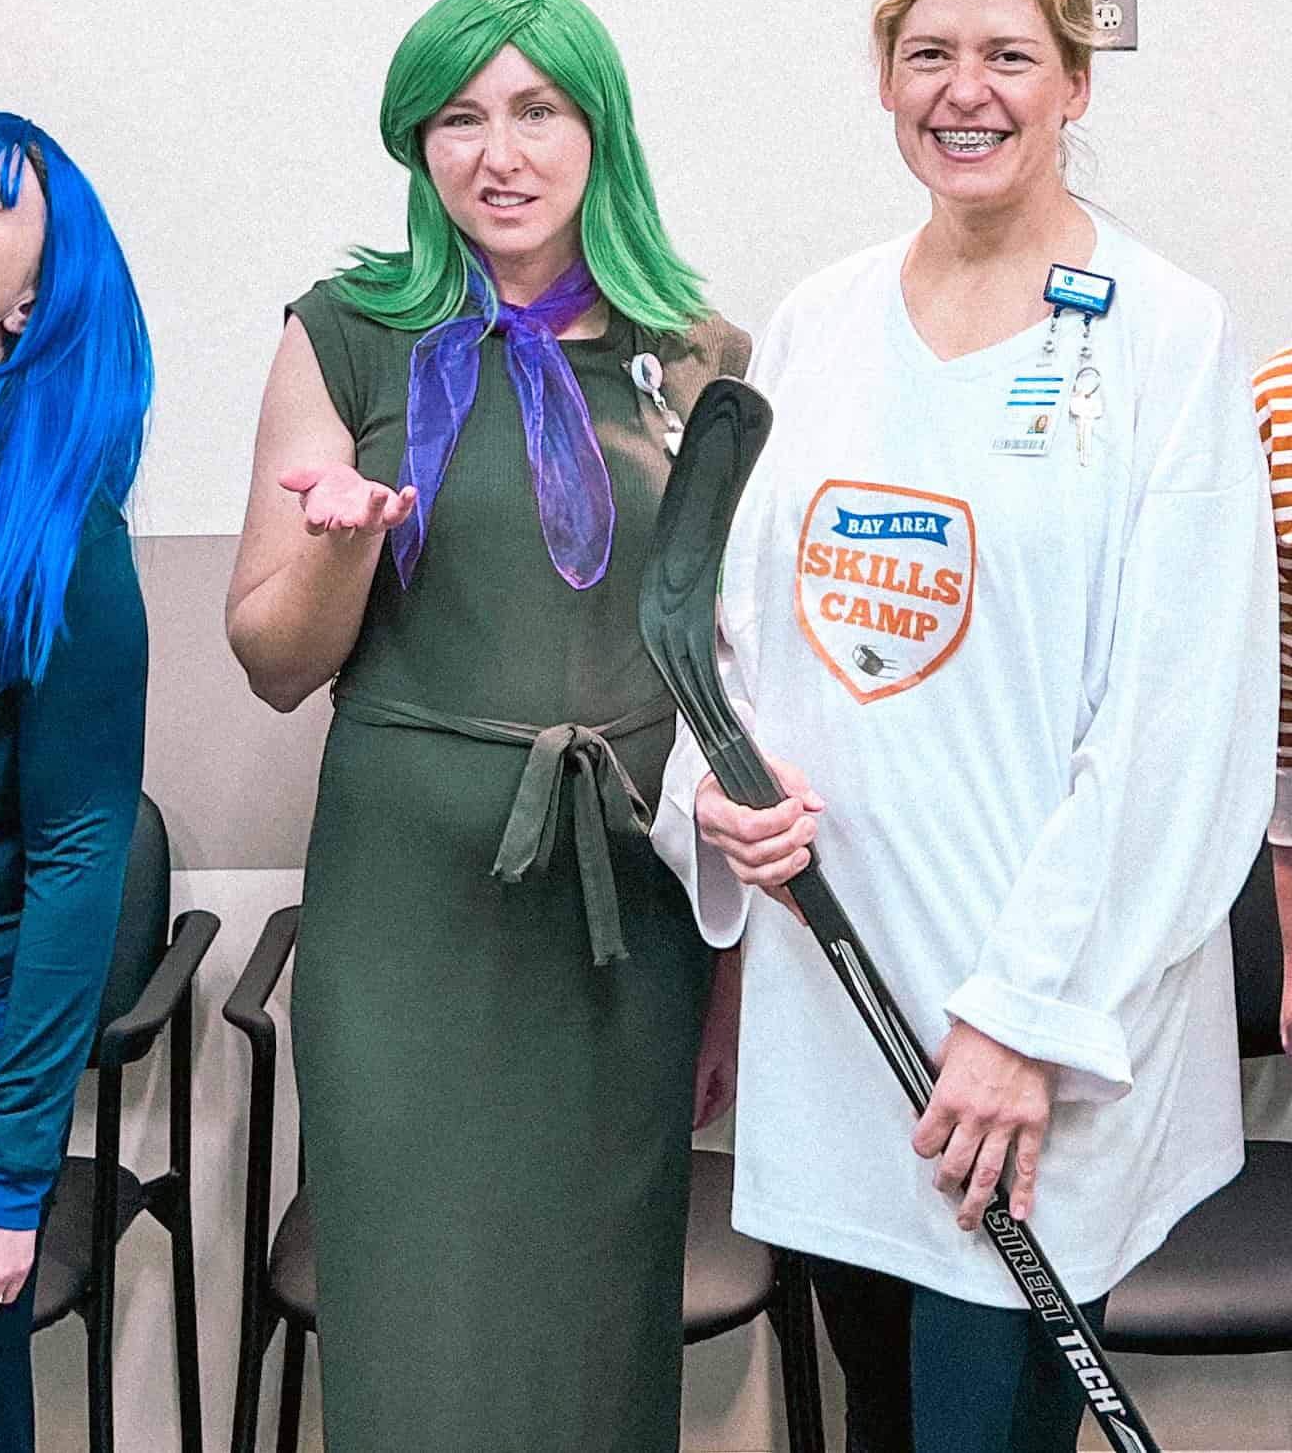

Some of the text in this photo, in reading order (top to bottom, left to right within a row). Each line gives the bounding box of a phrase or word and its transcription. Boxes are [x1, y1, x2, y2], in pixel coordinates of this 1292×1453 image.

[846, 516, 939, 534] BAY AREA
[804, 541, 964, 606] SKILLS
[819, 591, 939, 642] CAMP
[985, 1208, 1123, 1414] STREET TECH
